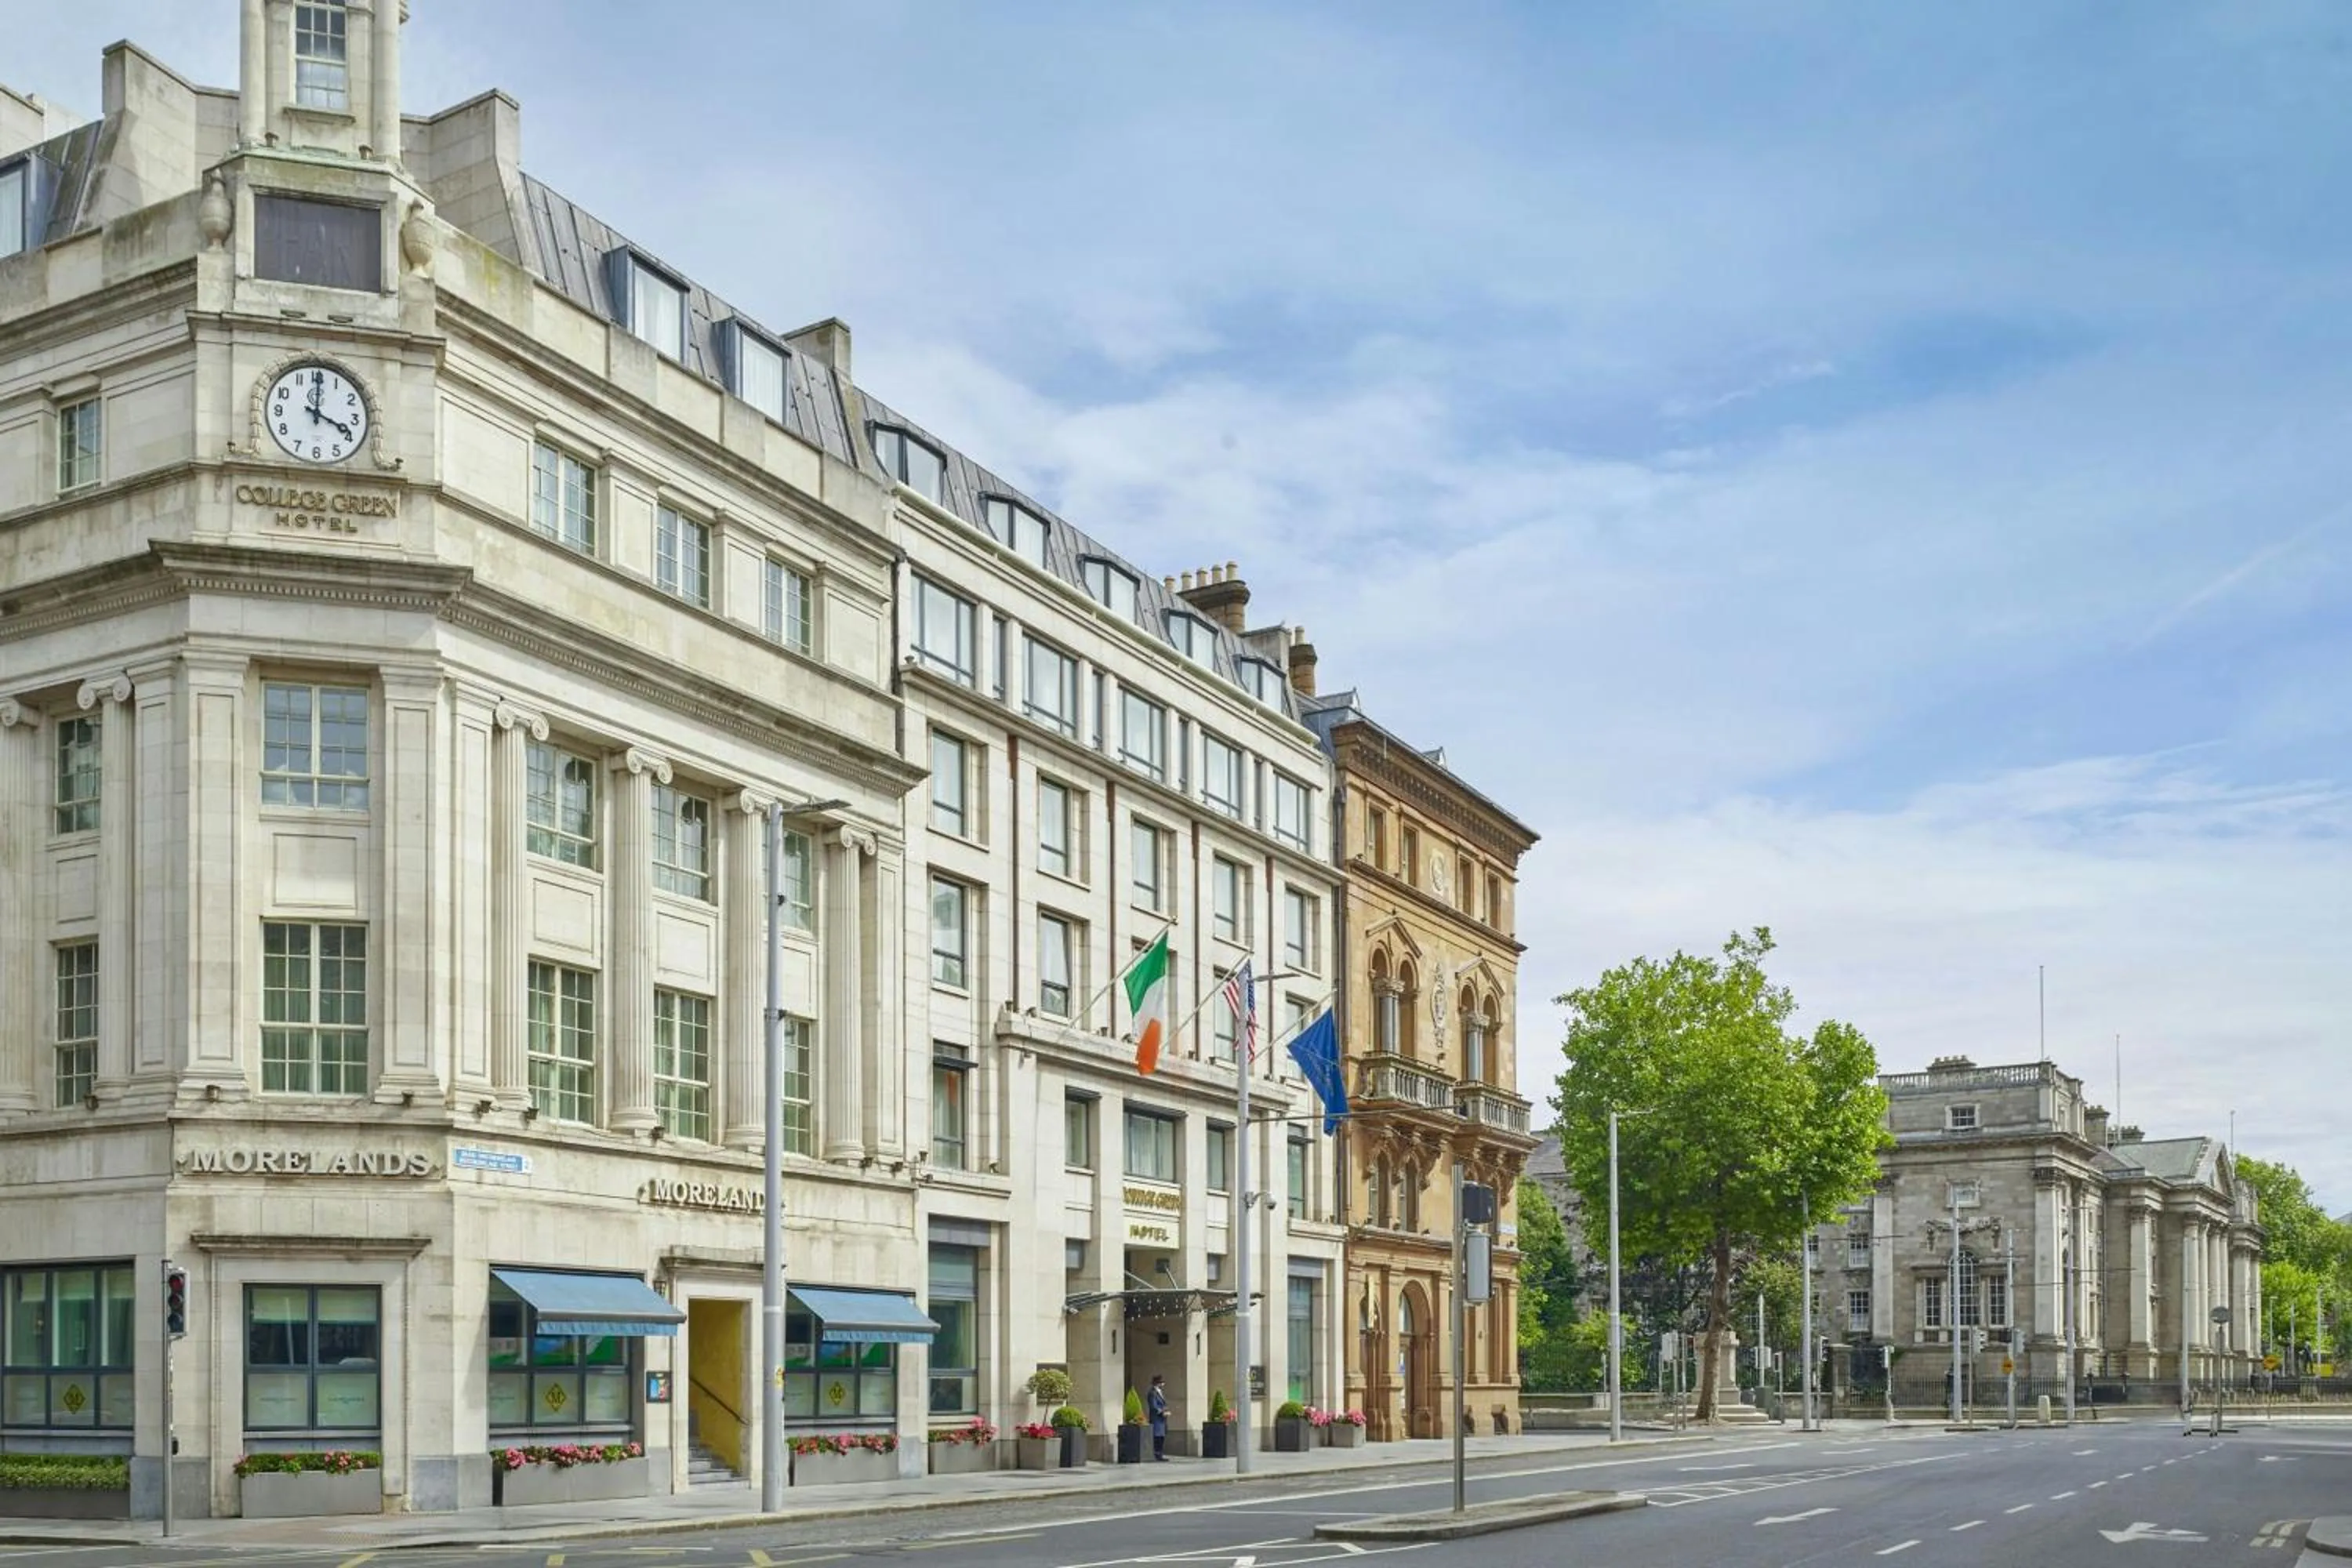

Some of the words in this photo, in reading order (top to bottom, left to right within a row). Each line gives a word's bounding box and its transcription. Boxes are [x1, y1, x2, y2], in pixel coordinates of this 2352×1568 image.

[295, 373, 303, 386] 11
[335, 377, 338, 390] 1
[278, 387, 289, 400] 10
[347, 393, 356, 405] 2
[274, 404, 283, 416] 9
[350, 414, 359, 426] 3
[279, 423, 288, 435] 8
[344, 430, 353, 443] 4
[293, 440, 302, 452] 7
[312, 446, 321, 459] 6
[332, 444, 341, 457] 5
[236, 485, 327, 511] COLLEGE
[331, 494, 397, 517] GREEN
[275, 513, 358, 533] HOTEL
[191, 1149, 433, 1176] MORELANDS
[655, 1178, 765, 1211] MORELAND
